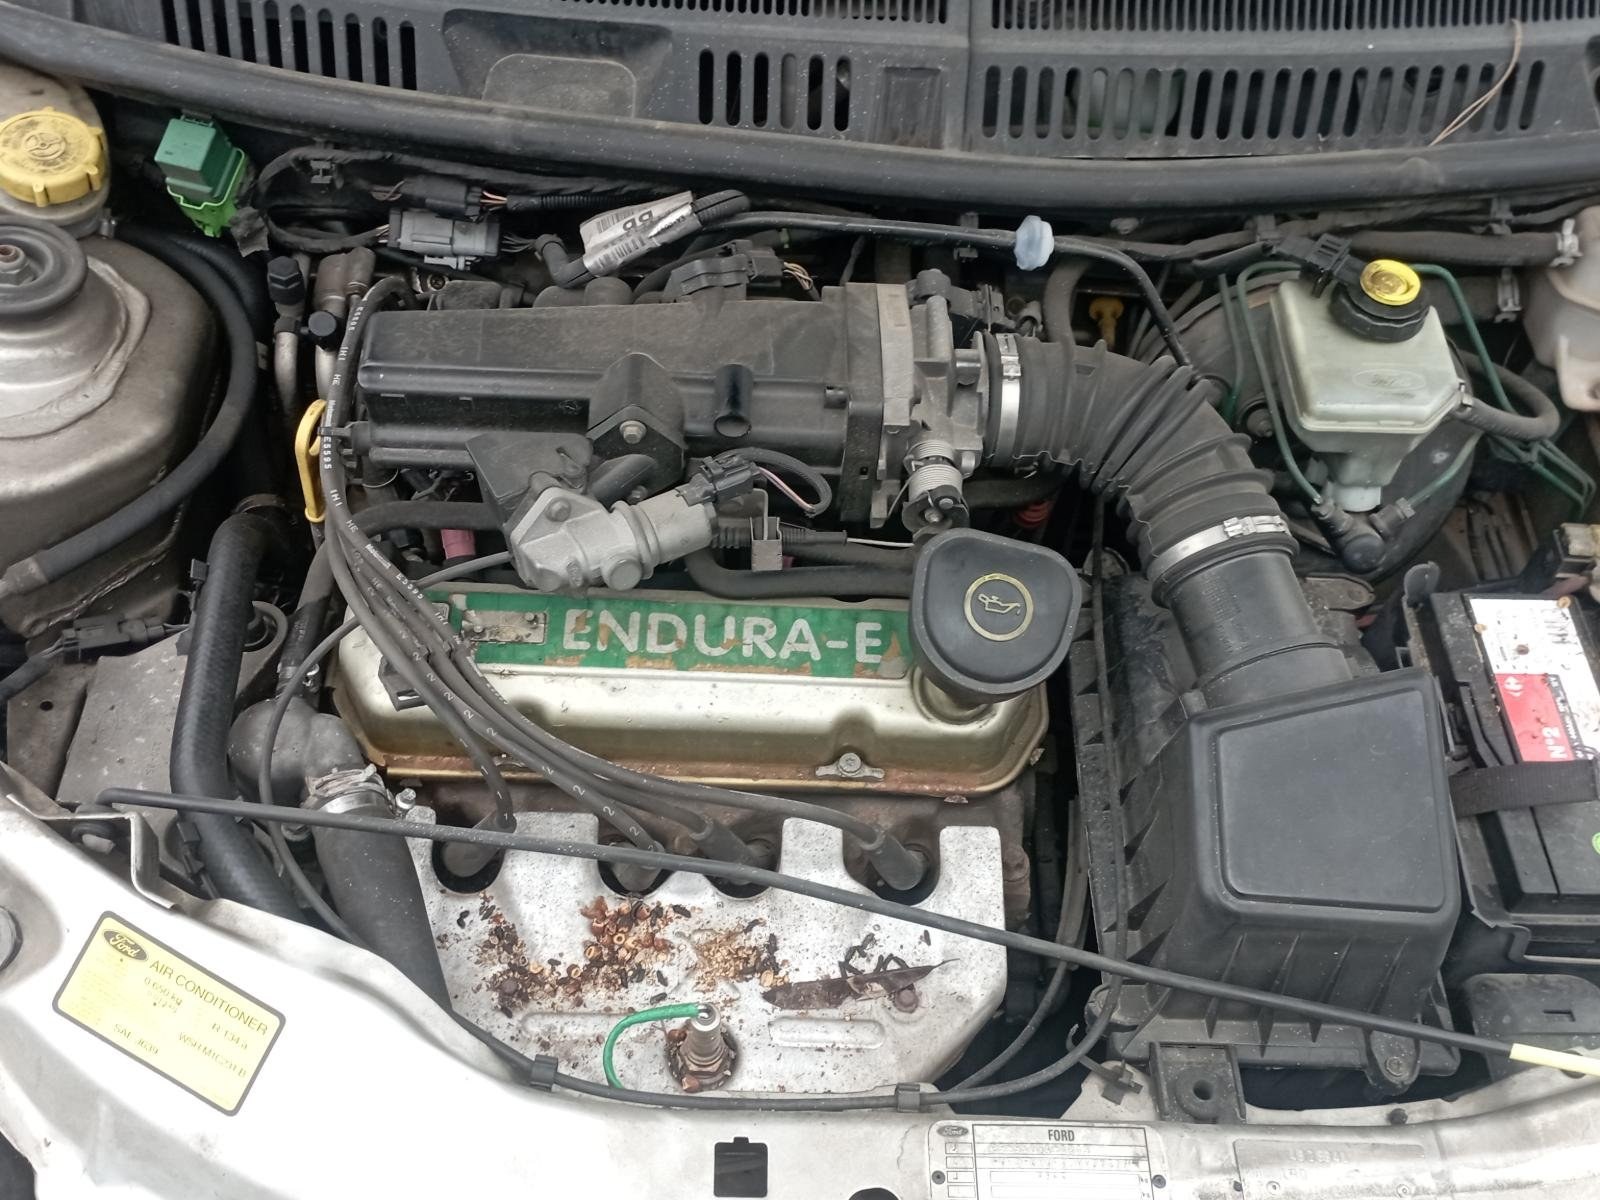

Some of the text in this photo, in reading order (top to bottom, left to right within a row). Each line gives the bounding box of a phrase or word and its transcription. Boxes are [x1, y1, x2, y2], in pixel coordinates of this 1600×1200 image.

[562, 608, 883, 664] ENDURA-E
[109, 932, 142, 959] Ford
[149, 959, 175, 980] AIR
[174, 973, 269, 1037] CONDITIONER
[1048, 1128, 1076, 1142] FORD
